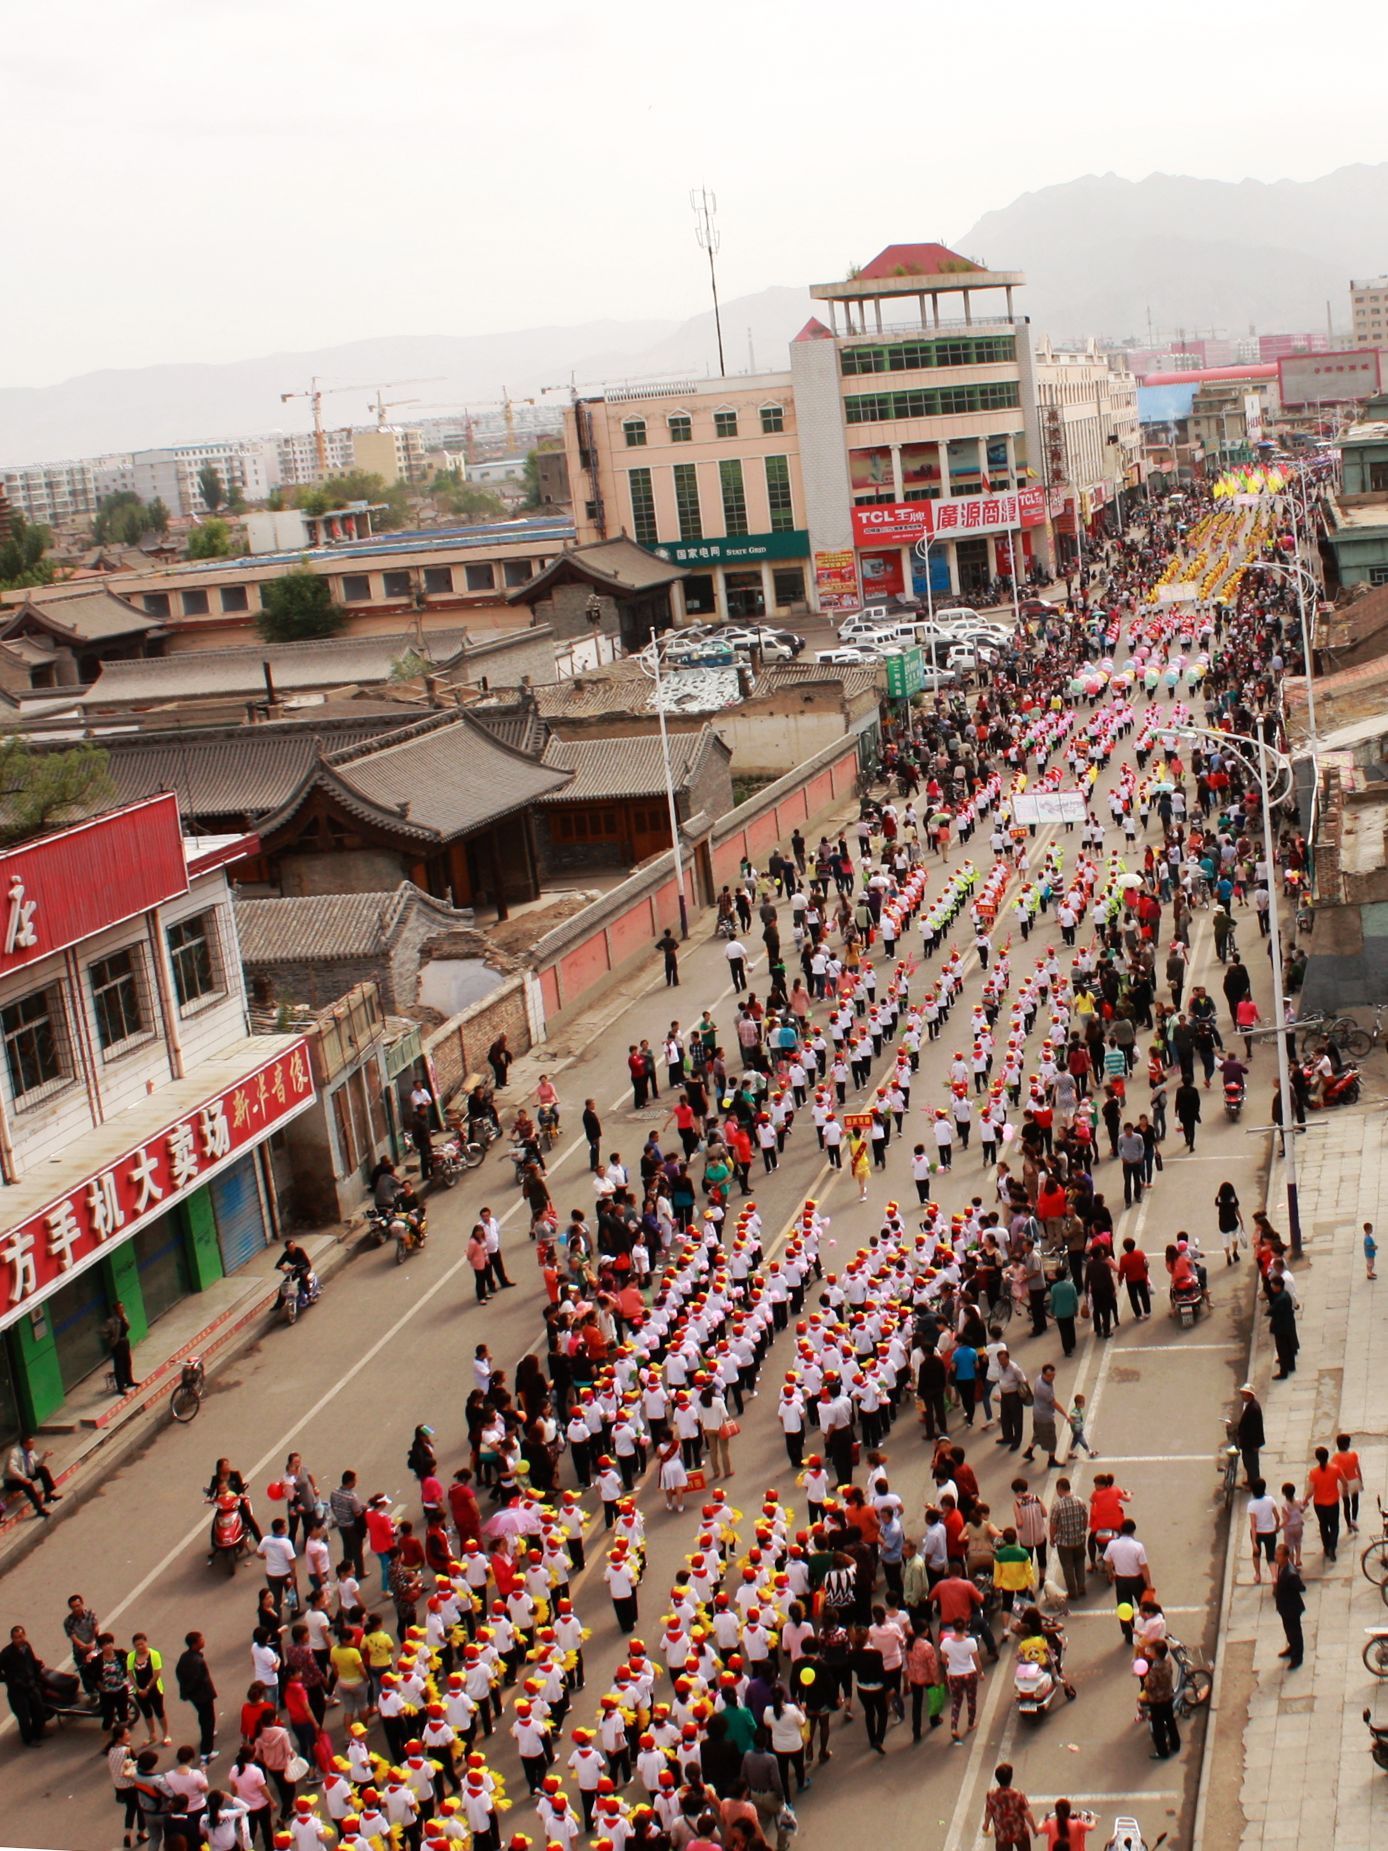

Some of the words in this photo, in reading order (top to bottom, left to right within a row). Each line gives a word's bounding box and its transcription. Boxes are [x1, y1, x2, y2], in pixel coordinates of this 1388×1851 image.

[676, 546, 721, 560] 国家电网
[1, 1100, 231, 1303] 方手机大卖场
